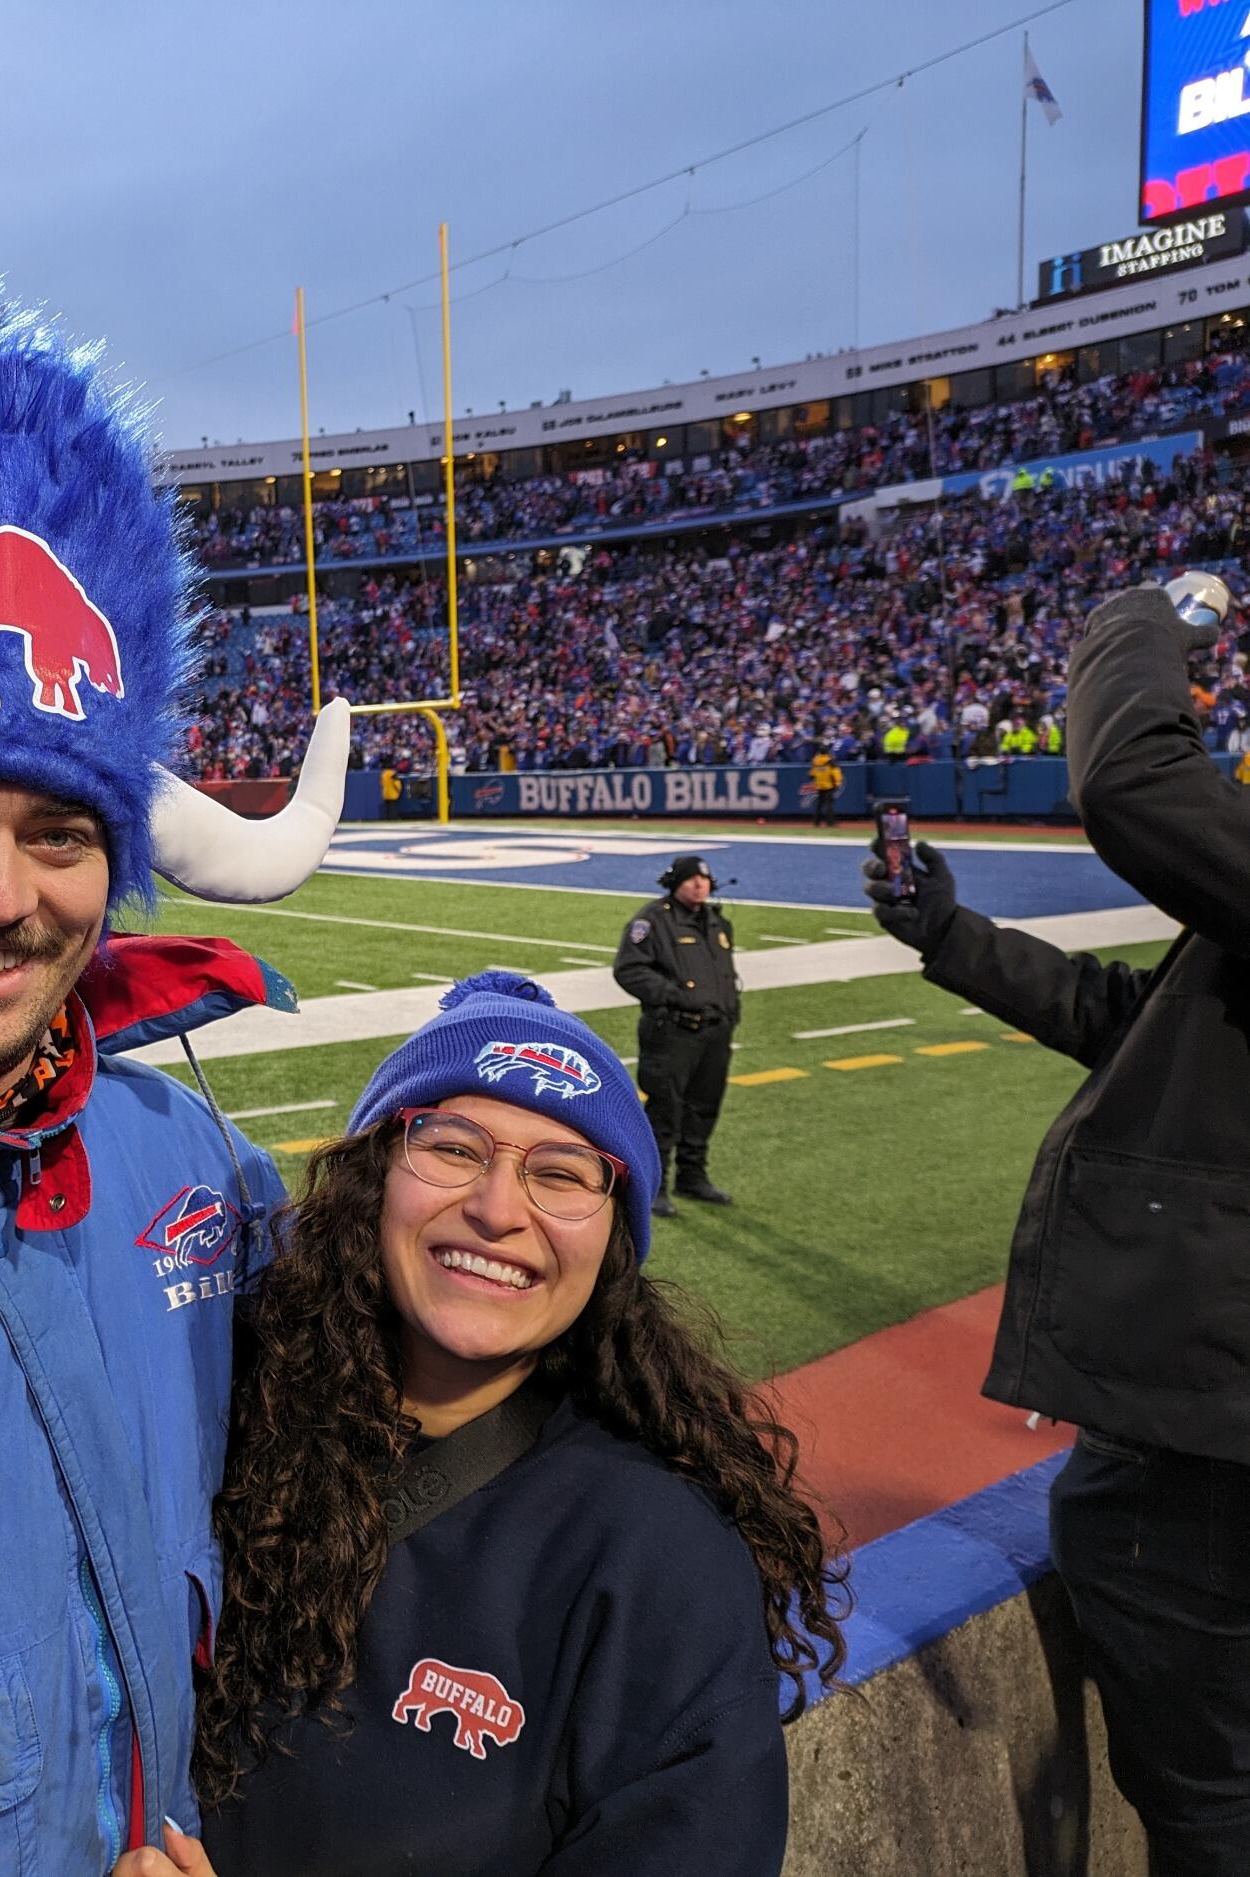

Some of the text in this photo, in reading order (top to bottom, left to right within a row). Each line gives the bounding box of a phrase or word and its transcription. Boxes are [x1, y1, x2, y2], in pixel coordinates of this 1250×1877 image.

[1100, 213, 1226, 268] IMAGINE
[1117, 243, 1204, 278] STAFFING
[1206, 279, 1241, 297] TOM
[519, 769, 780, 811] BUFFALO BILLS
[421, 1668, 512, 1728] BUFFALO
